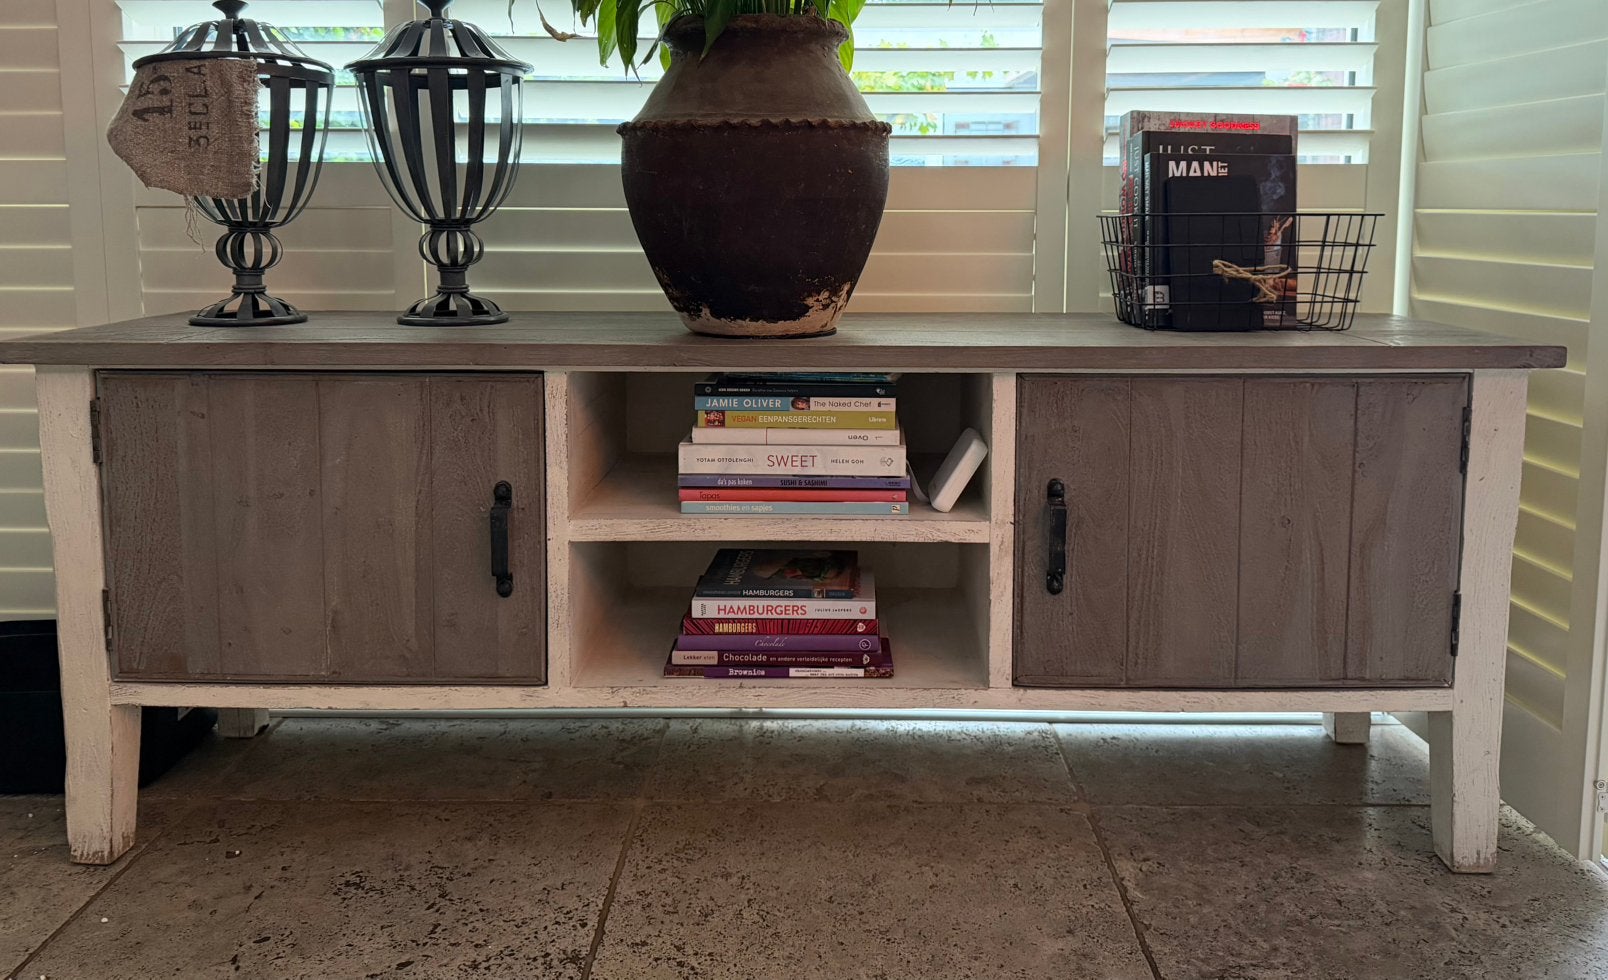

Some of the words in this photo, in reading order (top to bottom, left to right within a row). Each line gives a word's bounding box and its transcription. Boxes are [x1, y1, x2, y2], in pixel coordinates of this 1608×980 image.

[1168, 160, 1218, 178] MAN
[705, 398, 738, 408] JAMIE
[743, 398, 781, 408] OLIVER
[814, 400, 826, 408] The
[828, 400, 852, 408] Naked
[854, 400, 872, 408] Chef
[731, 415, 757, 423] VEGAN
[758, 415, 836, 423] EENPANSGERECHTEN
[767, 454, 818, 468] SWEET
[804, 479, 828, 487] SASHIMI
[699, 491, 720, 501] Tapas
[751, 504, 773, 513] sapjes
[742, 589, 794, 597] HAMBURGERS
[717, 604, 807, 616] HAMBURGERS
[714, 622, 757, 633] HAMBURGERS
[723, 653, 768, 662] Chocolade
[728, 668, 766, 676] Brownies
